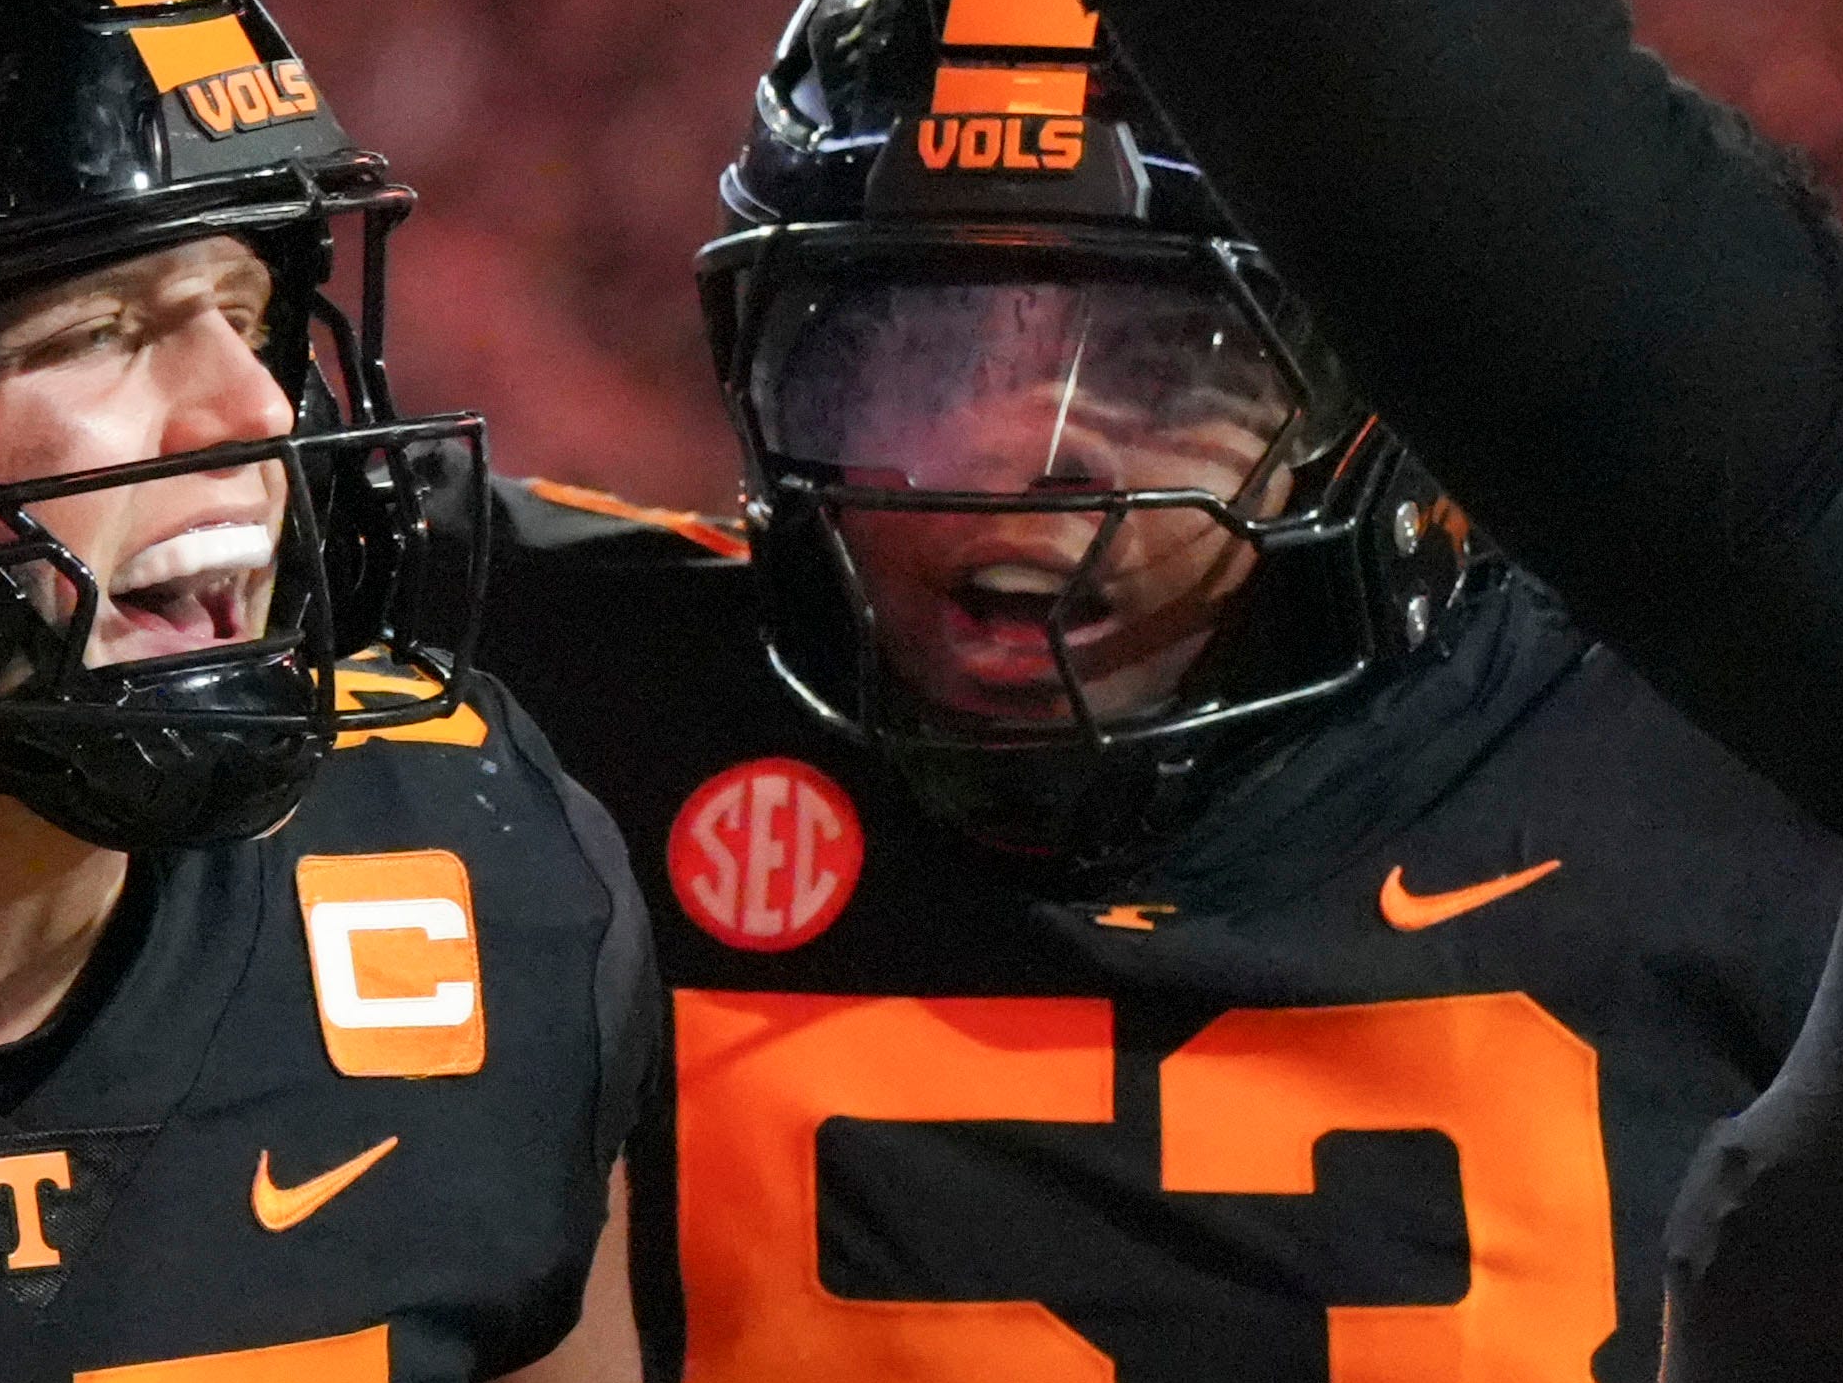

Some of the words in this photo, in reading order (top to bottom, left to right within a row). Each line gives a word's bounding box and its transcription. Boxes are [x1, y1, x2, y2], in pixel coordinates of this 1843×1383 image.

[186, 63, 318, 132] VOLS
[918, 119, 1083, 170] VOLS
[691, 775, 842, 937] SEC
[309, 897, 474, 1029] C
